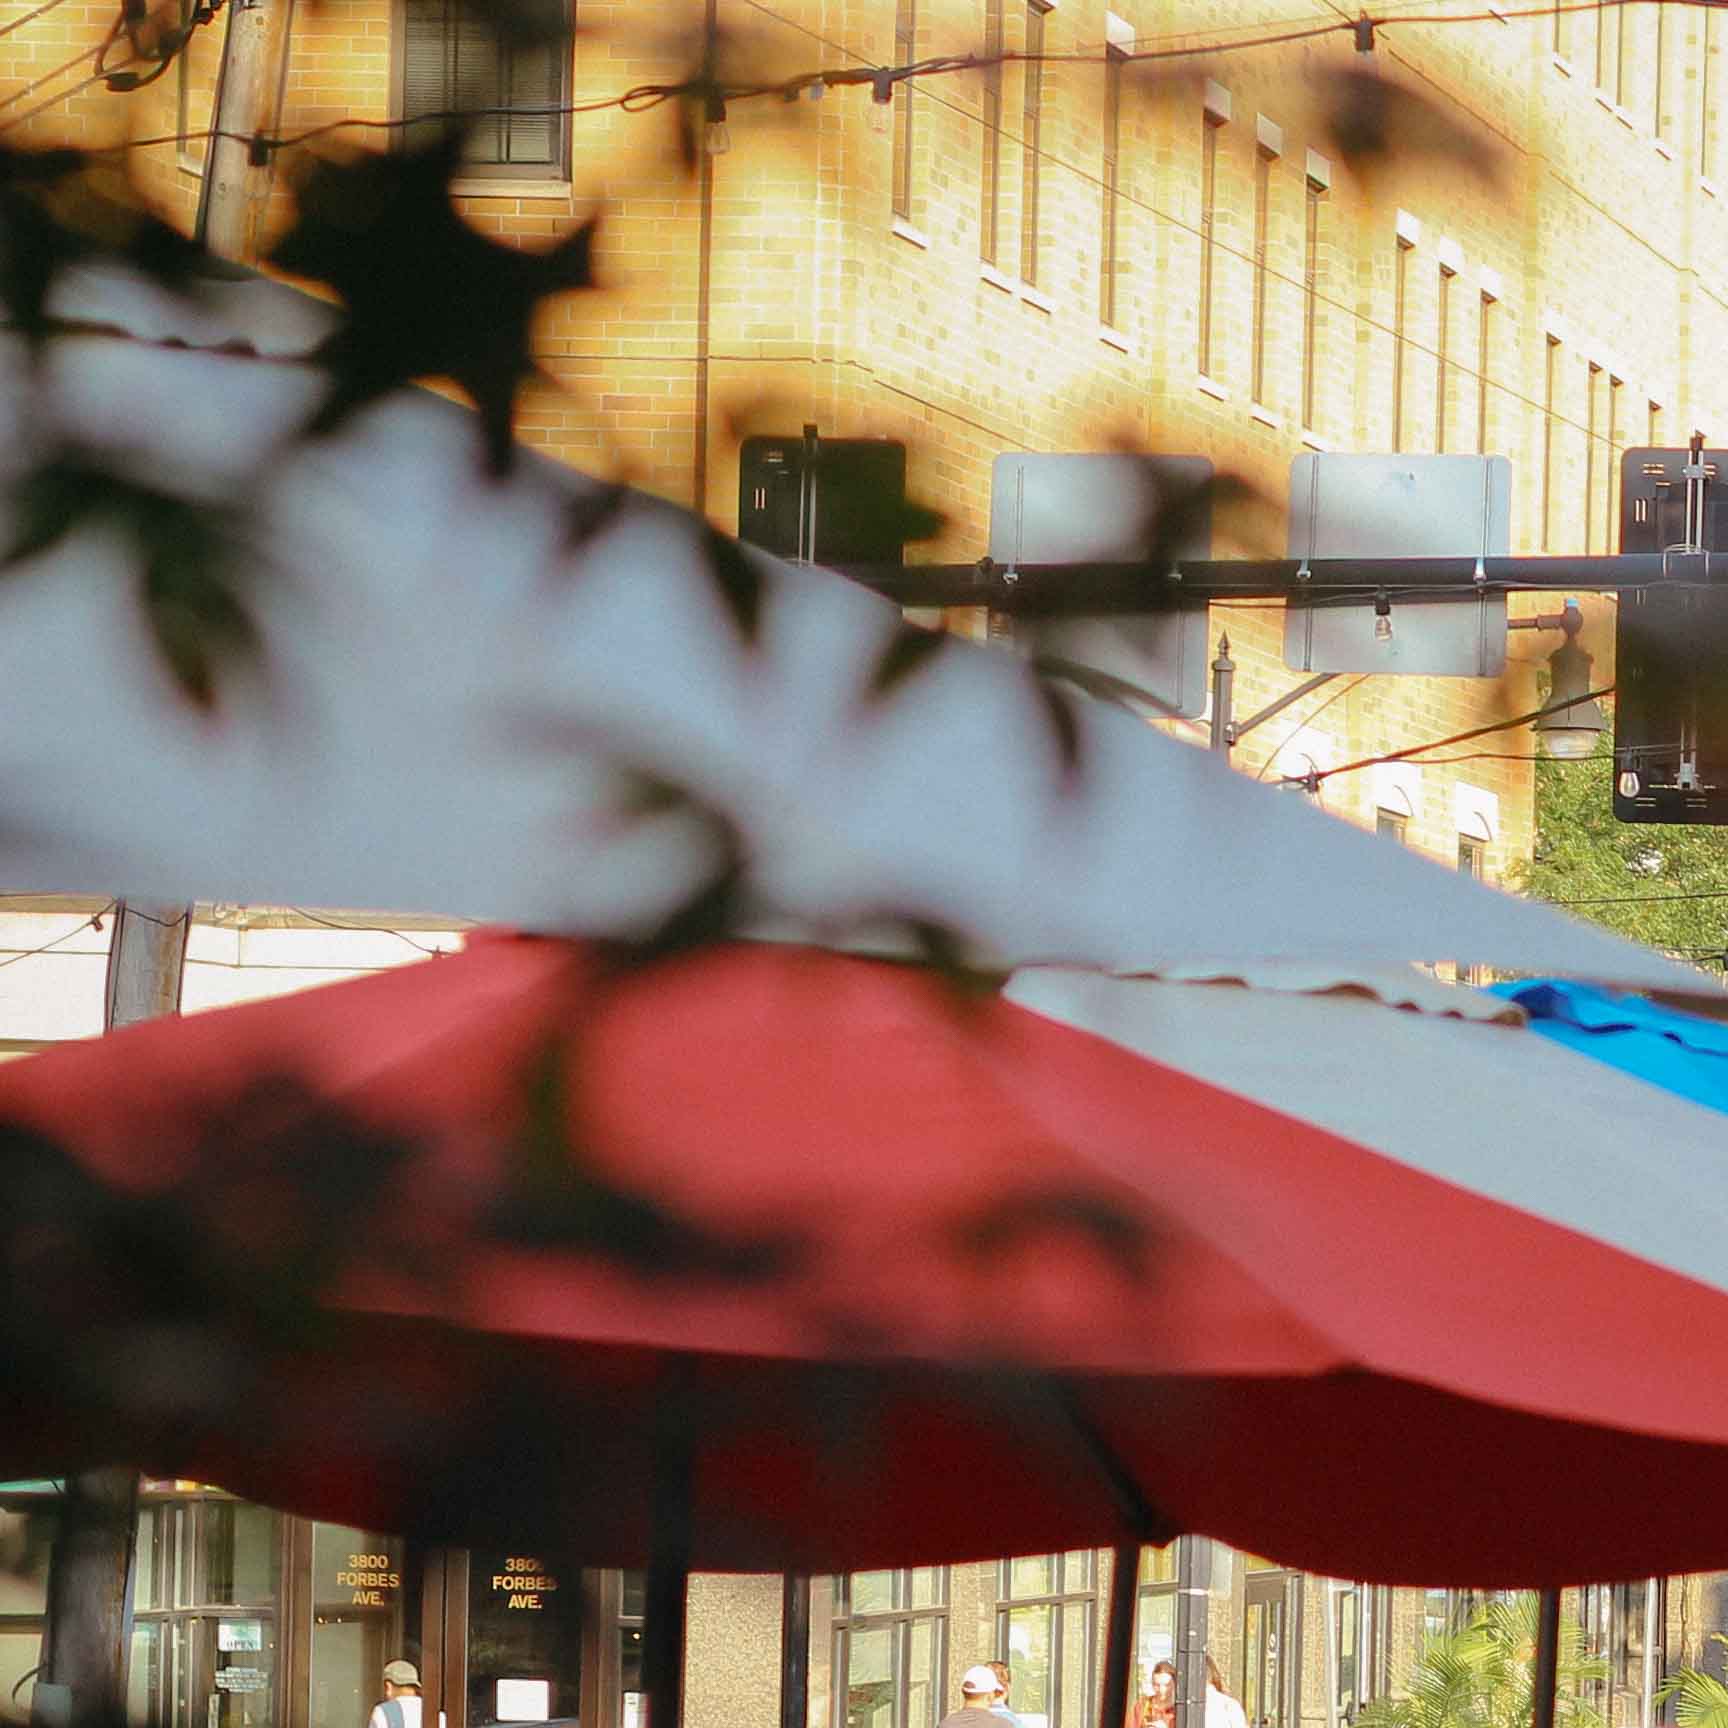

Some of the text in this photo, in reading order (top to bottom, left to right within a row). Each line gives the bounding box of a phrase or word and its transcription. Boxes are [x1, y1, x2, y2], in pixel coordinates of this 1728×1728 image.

[349, 1554, 388, 1569] 3800
[336, 1571, 400, 1588] FORBES
[352, 1591, 384, 1606] AVE.
[508, 1594, 542, 1609] AVE.
